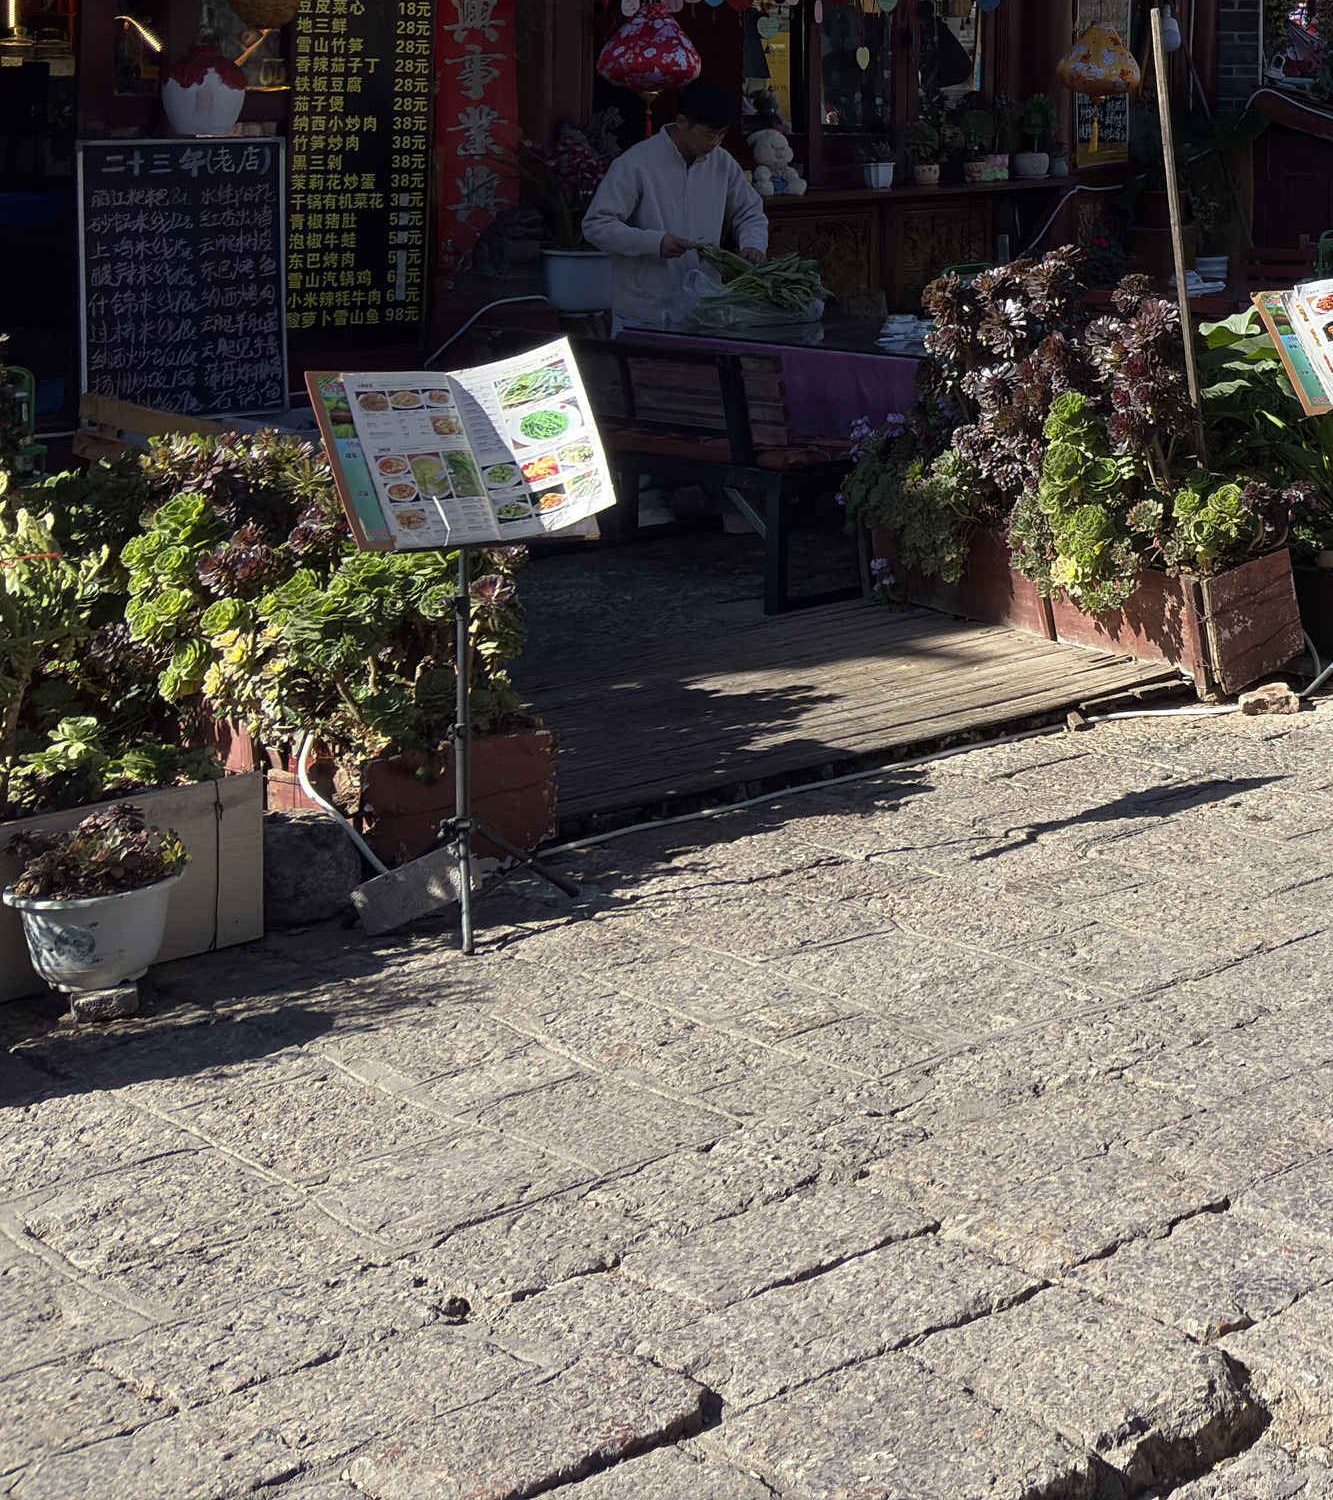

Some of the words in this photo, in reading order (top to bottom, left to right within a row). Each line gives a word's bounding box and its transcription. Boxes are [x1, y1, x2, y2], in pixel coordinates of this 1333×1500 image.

[398, 2, 431, 17] 18元
[297, 17, 348, 34] 地三鲜
[396, 21, 430, 36] 28元
[296, 36, 364, 53] 雪山竹笋
[395, 40, 430, 55] 28元
[295, 56, 380, 74] 香辣茄子丁
[395, 59, 429, 74] 28元
[294, 76, 363, 93] 铁板豆腐
[394, 78, 428, 93] 28元
[294, 96, 344, 112] 茄子煲
[393, 97, 427, 112] 28元
[293, 115, 377, 132] 纳西小炒肉
[393, 117, 427, 131] 38元
[293, 135, 359, 151] 竹笋炒肉
[392, 136, 426, 150] 38元
[292, 154, 342, 171] 黑三剁
[391, 155, 426, 169] 38元
[291, 173, 375, 191] 茉莉花炒蛋
[391, 174, 425, 188] 38元
[291, 193, 384, 210] 干锅有机菜花
[390, 192, 424, 207] 3元
[290, 213, 357, 231] 青椒猪肚
[390, 211, 423, 226] 5元
[289, 231, 356, 250] 泡椒牛蛙
[389, 230, 422, 245] 5元
[288, 251, 355, 269] 东巴烤肉
[388, 249, 422, 265] 5元
[288, 269, 372, 289] 雪山汽锅鸡
[387, 268, 420, 284] 6元
[287, 289, 381, 309] 小米辣牦牛肉
[386, 287, 420, 302] 6元
[287, 309, 379, 328] 酸萝卜雪山鱼
[385, 307, 419, 321] 98元
